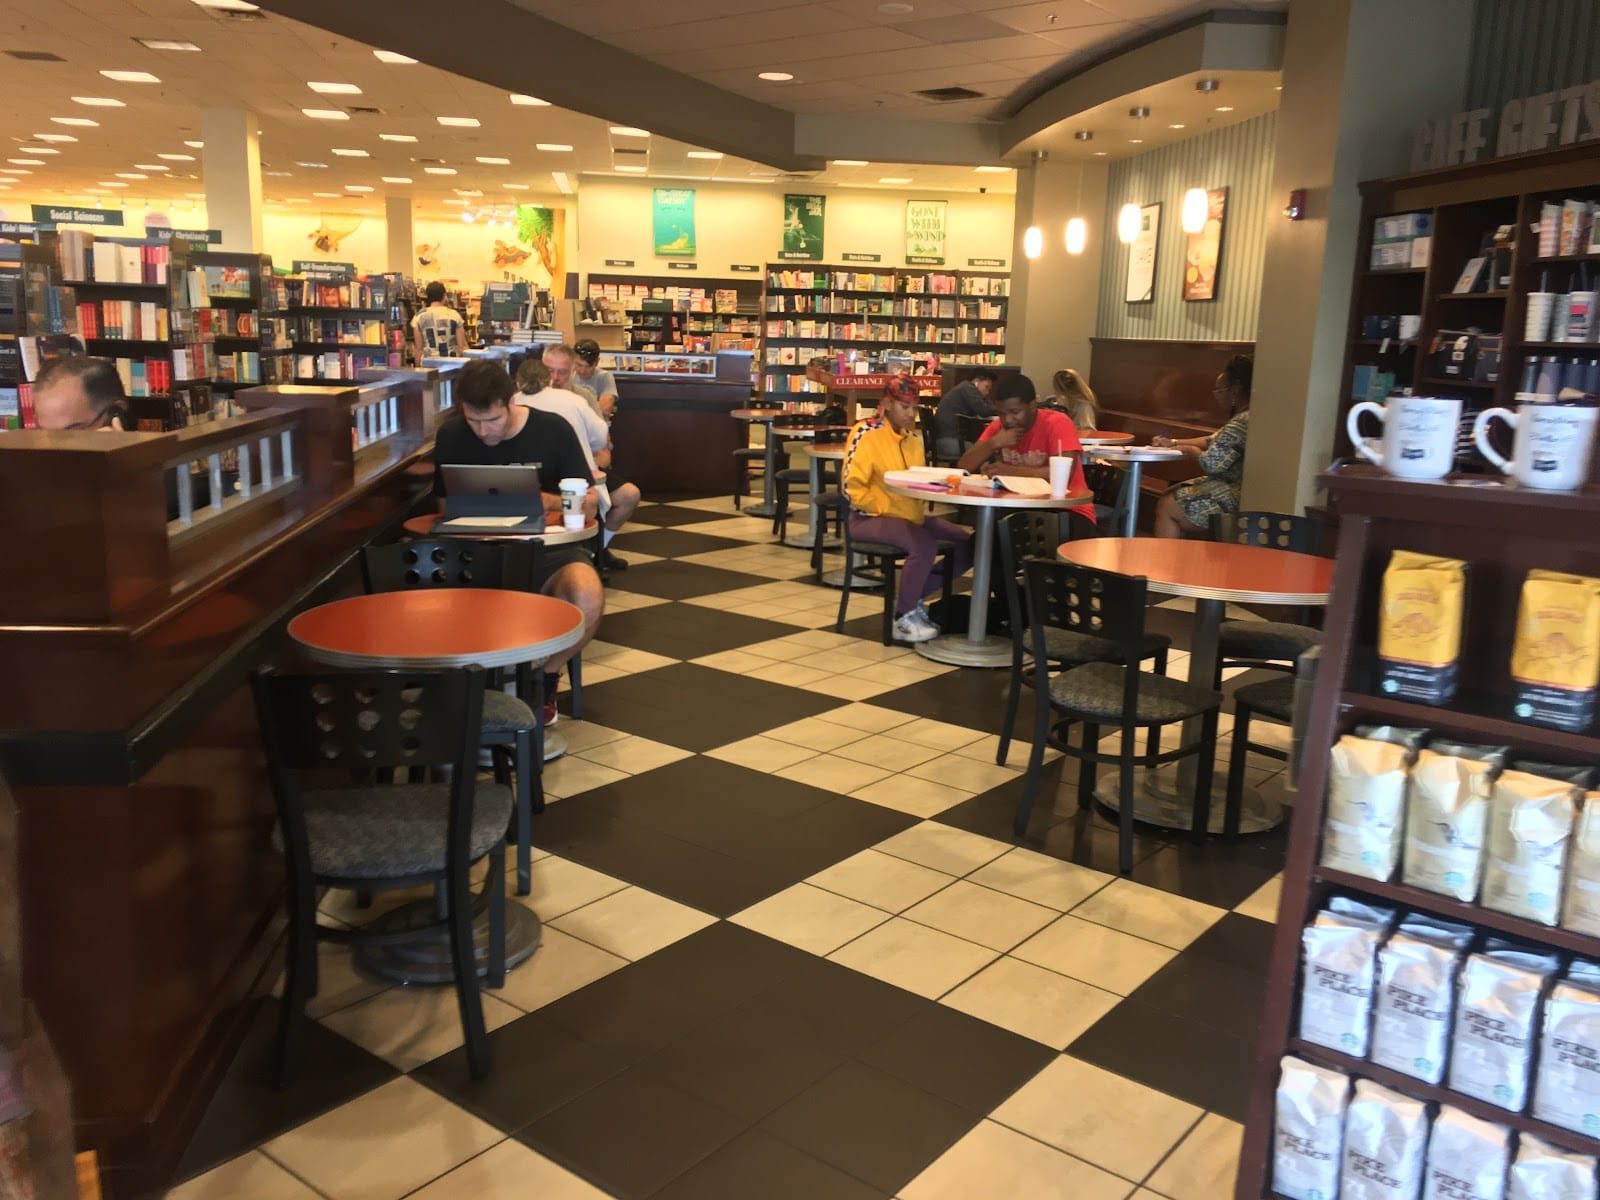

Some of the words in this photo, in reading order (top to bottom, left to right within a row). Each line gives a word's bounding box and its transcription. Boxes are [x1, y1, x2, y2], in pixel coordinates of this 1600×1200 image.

[50, 209, 72, 220] Social
[73, 211, 104, 222] Sciences
[836, 377, 885, 386] CLEARANCE
